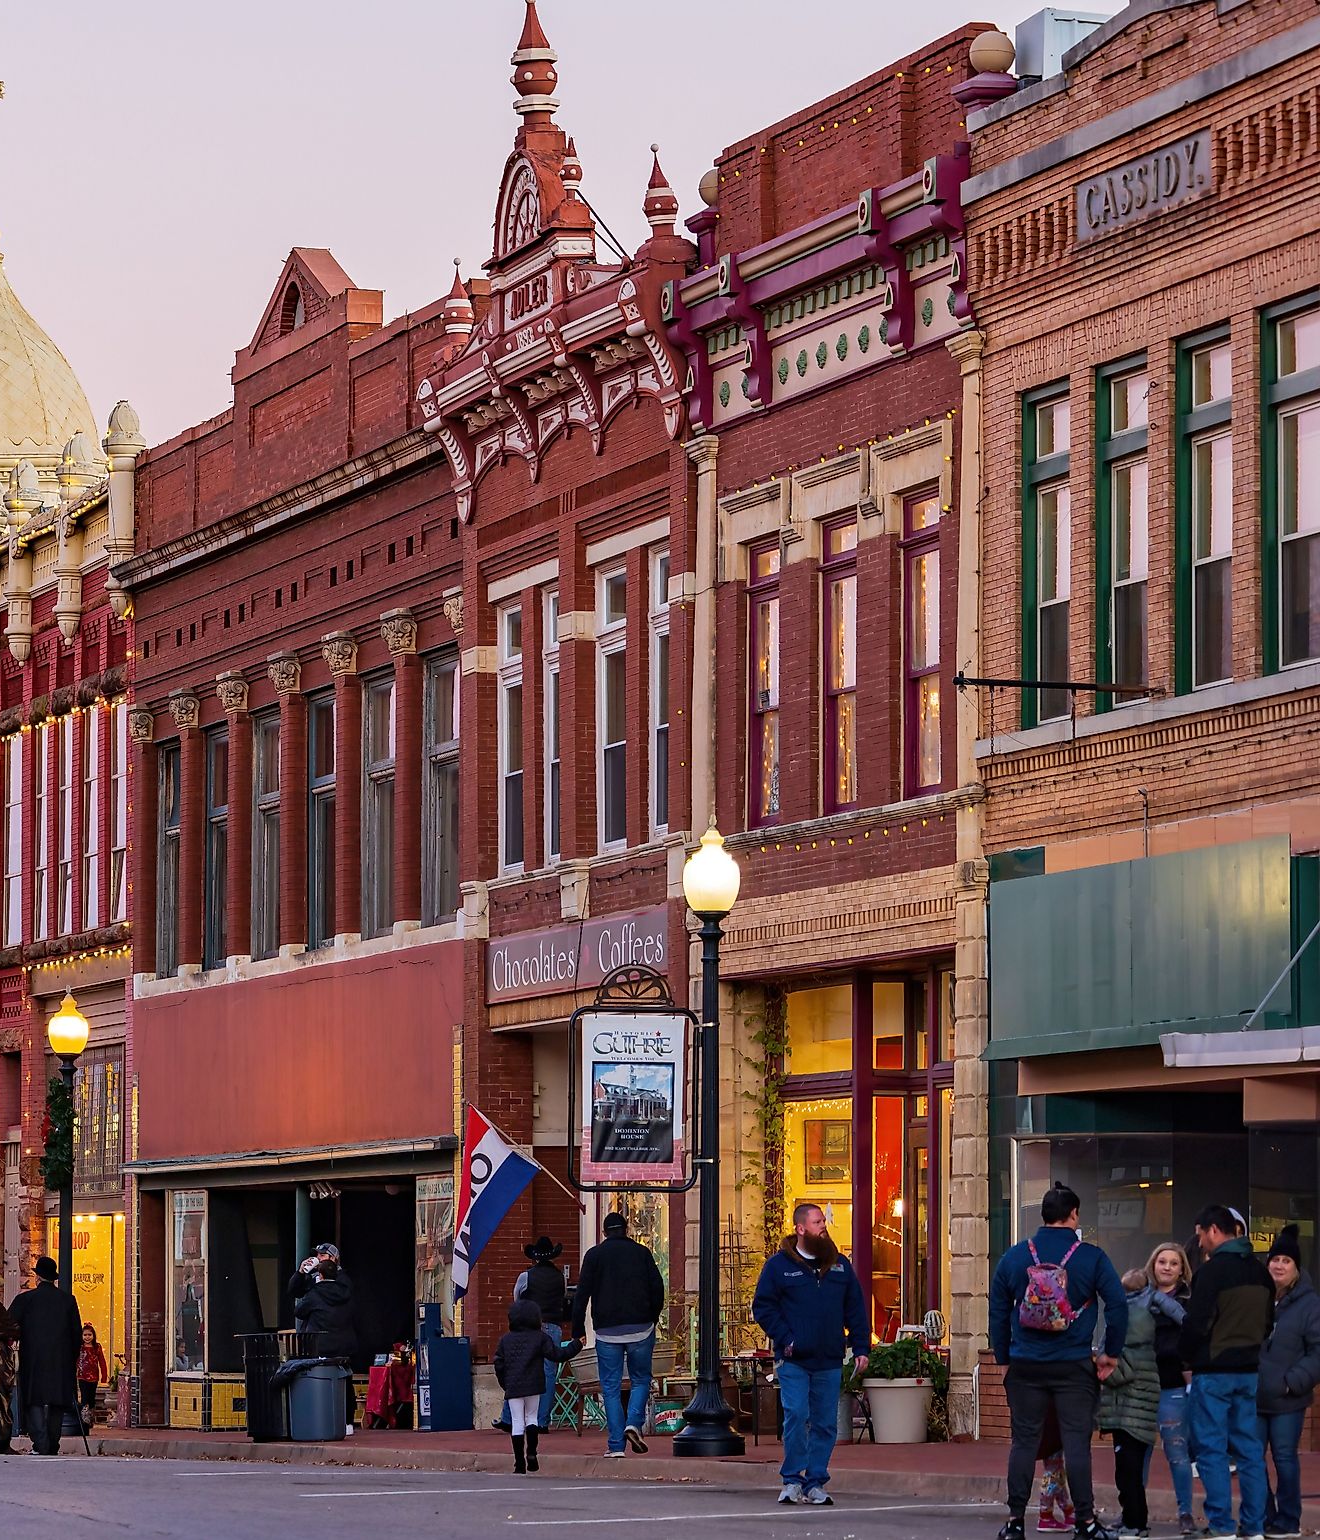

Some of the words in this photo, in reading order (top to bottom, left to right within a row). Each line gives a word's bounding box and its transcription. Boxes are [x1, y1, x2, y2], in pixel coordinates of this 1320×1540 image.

[510, 275, 548, 321] ADLER
[492, 940, 575, 992] Chocolates
[598, 922, 664, 973] Coffees
[593, 1032, 673, 1057] GUTHRIE
[73, 1273, 92, 1284] BARBER
[93, 1273, 105, 1284] SHOP
